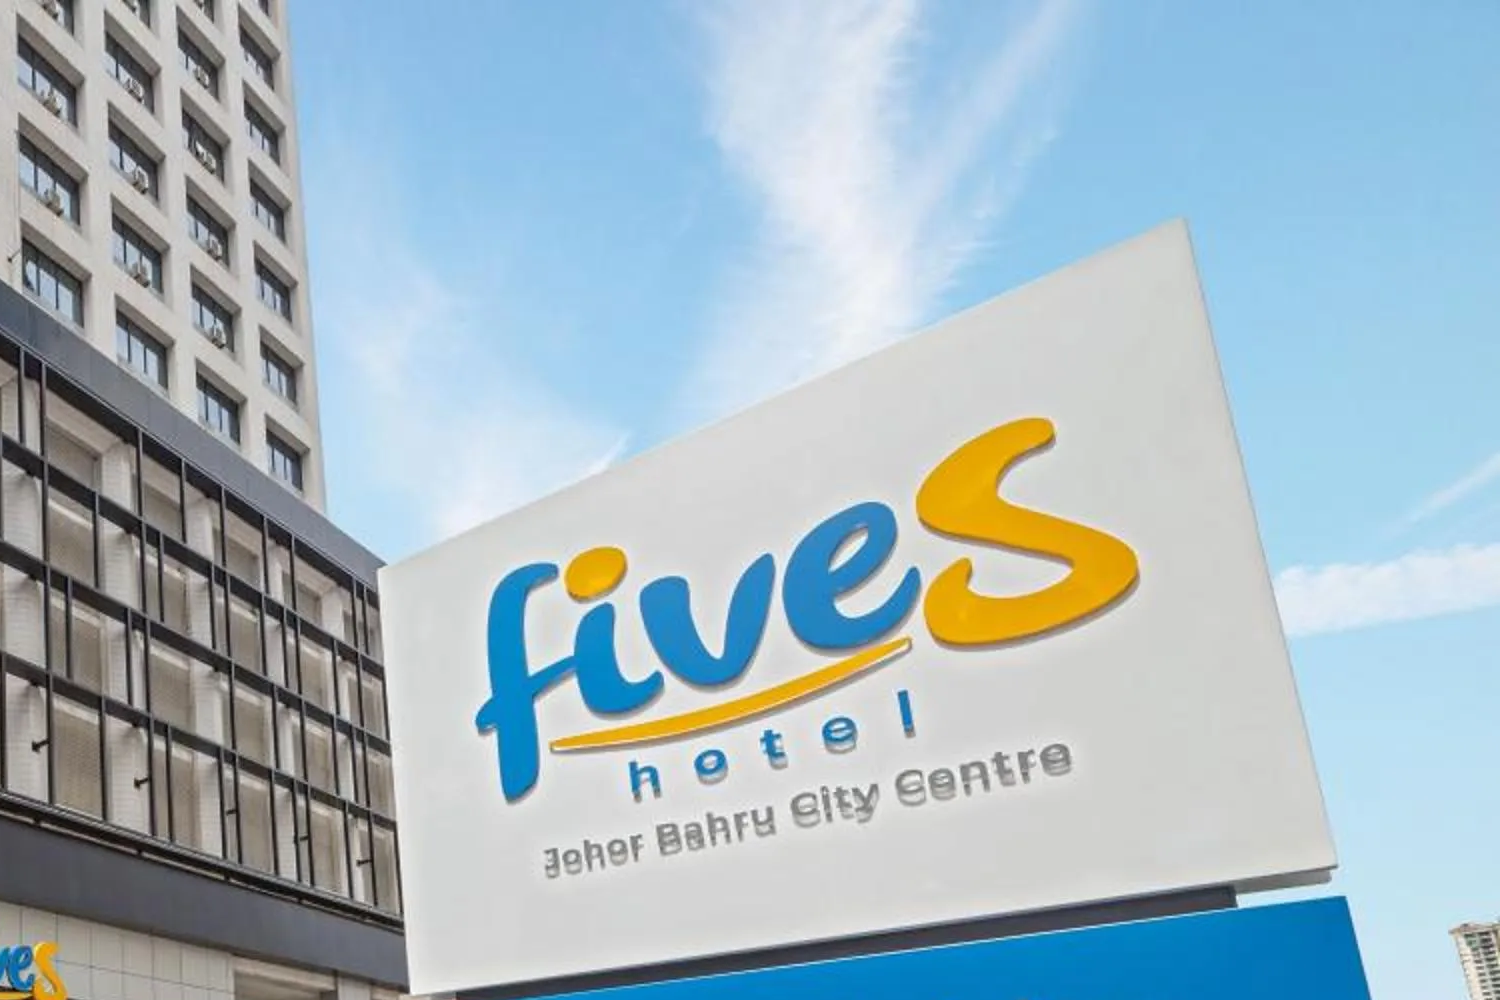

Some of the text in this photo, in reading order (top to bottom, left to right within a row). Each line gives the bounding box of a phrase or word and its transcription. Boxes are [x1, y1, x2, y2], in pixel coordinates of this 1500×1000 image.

[628, 690, 917, 801] hotel
[543, 743, 1072, 878] Johor Bahru City Centre
